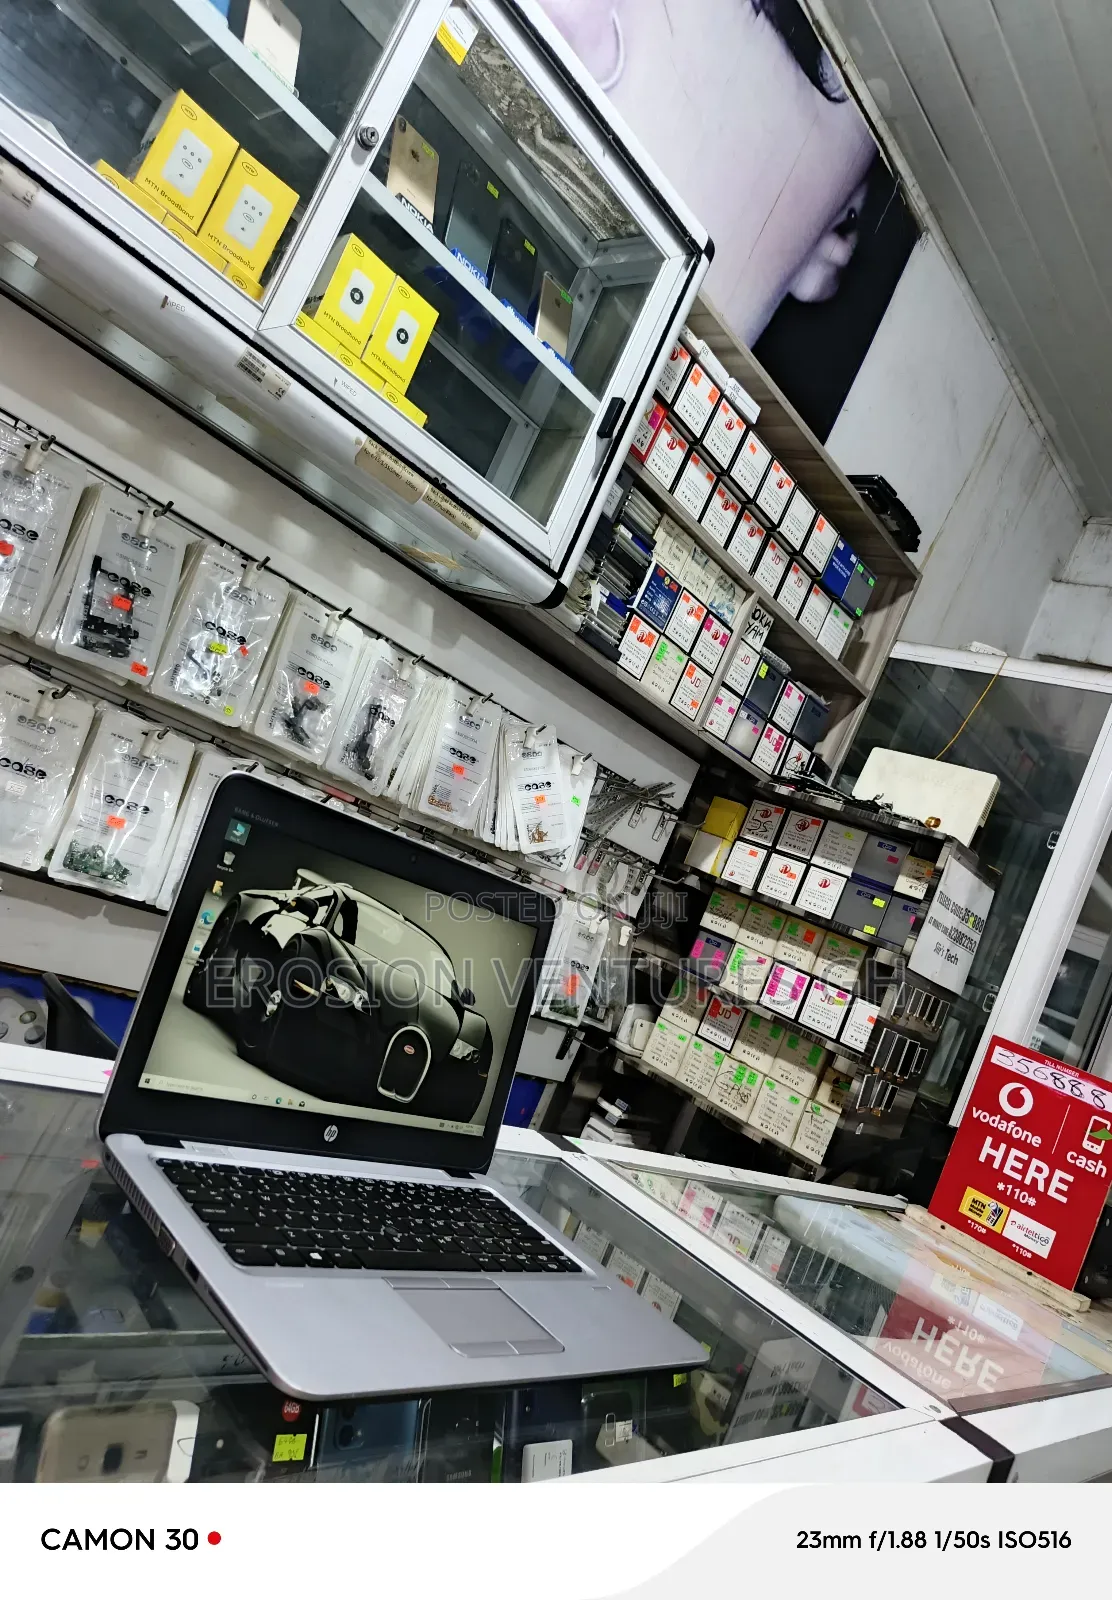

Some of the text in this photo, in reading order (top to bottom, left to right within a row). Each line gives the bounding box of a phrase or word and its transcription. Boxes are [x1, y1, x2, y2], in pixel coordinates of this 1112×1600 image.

[145, 177, 195, 221] MTN Broadband
[401, 197, 434, 234] NOKIA
[208, 232, 256, 272] MTN Broadband
[456, 254, 487, 288] NOKIA
[324, 310, 362, 346] MTN Broadband
[371, 351, 406, 384] MTN Broadband
[0, 518, 39, 541] ase
[297, 666, 331, 690] case
[449, 747, 477, 765] case
[0, 757, 47, 779] case
[524, 780, 552, 791] case
[105, 794, 150, 814] case
[944, 948, 959, 966] Tech
[997, 1049, 1107, 1110] 356888
[1044, 1059, 1080, 1078] TILL NUMBER
[324, 1126, 338, 1141] hp
[972, 1106, 1042, 1148] vodafone
[978, 1136, 1075, 1204] HERE
[1066, 1150, 1108, 1178] cash
[968, 1207, 983, 1218] Money
[969, 1203, 984, 1214] Mobile
[972, 1198, 986, 1210] MTN
[1017, 1224, 1050, 1247] airteltigo
[1024, 1234, 1039, 1244] Money
